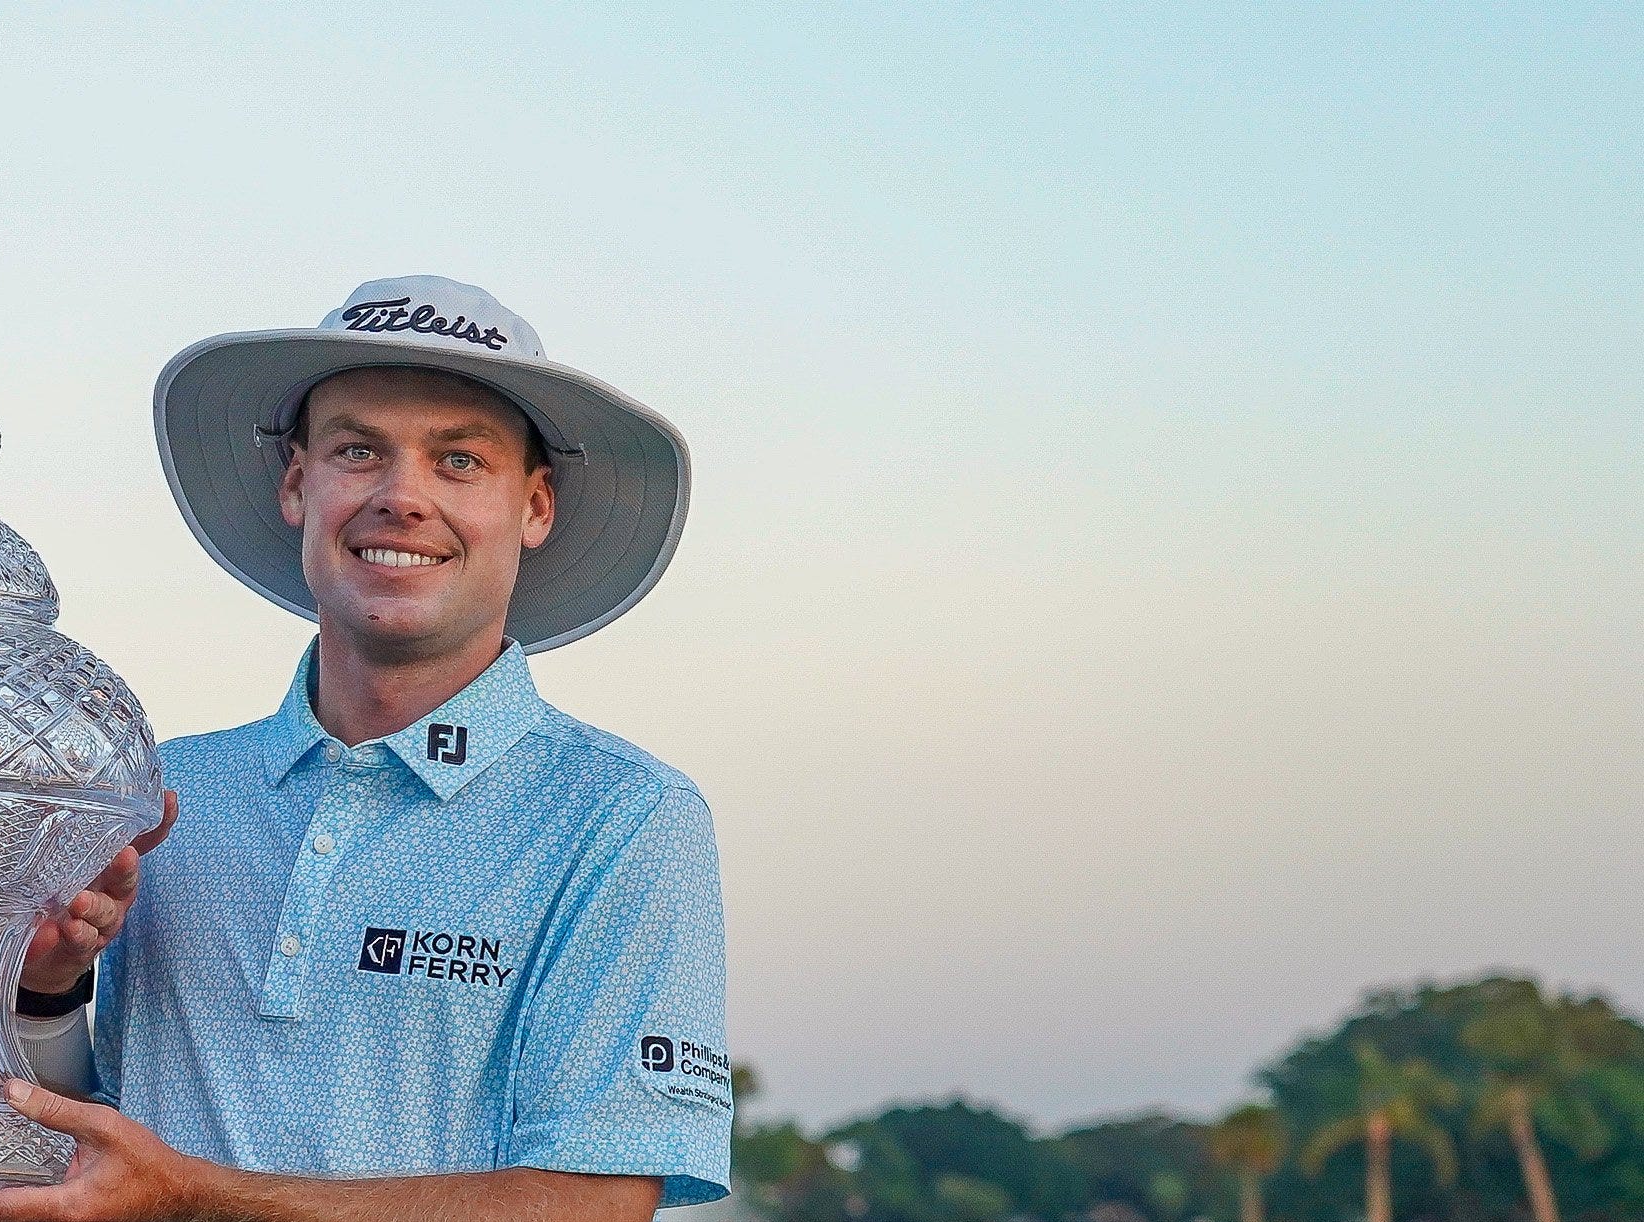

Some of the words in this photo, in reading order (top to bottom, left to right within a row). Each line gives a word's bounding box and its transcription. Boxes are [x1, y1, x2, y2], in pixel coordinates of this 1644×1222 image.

[342, 296, 508, 351] Titleist
[426, 722, 468, 767] FJ
[411, 930, 502, 962] KORN
[407, 955, 515, 988] FERRY
[680, 1059, 731, 1091] Company
